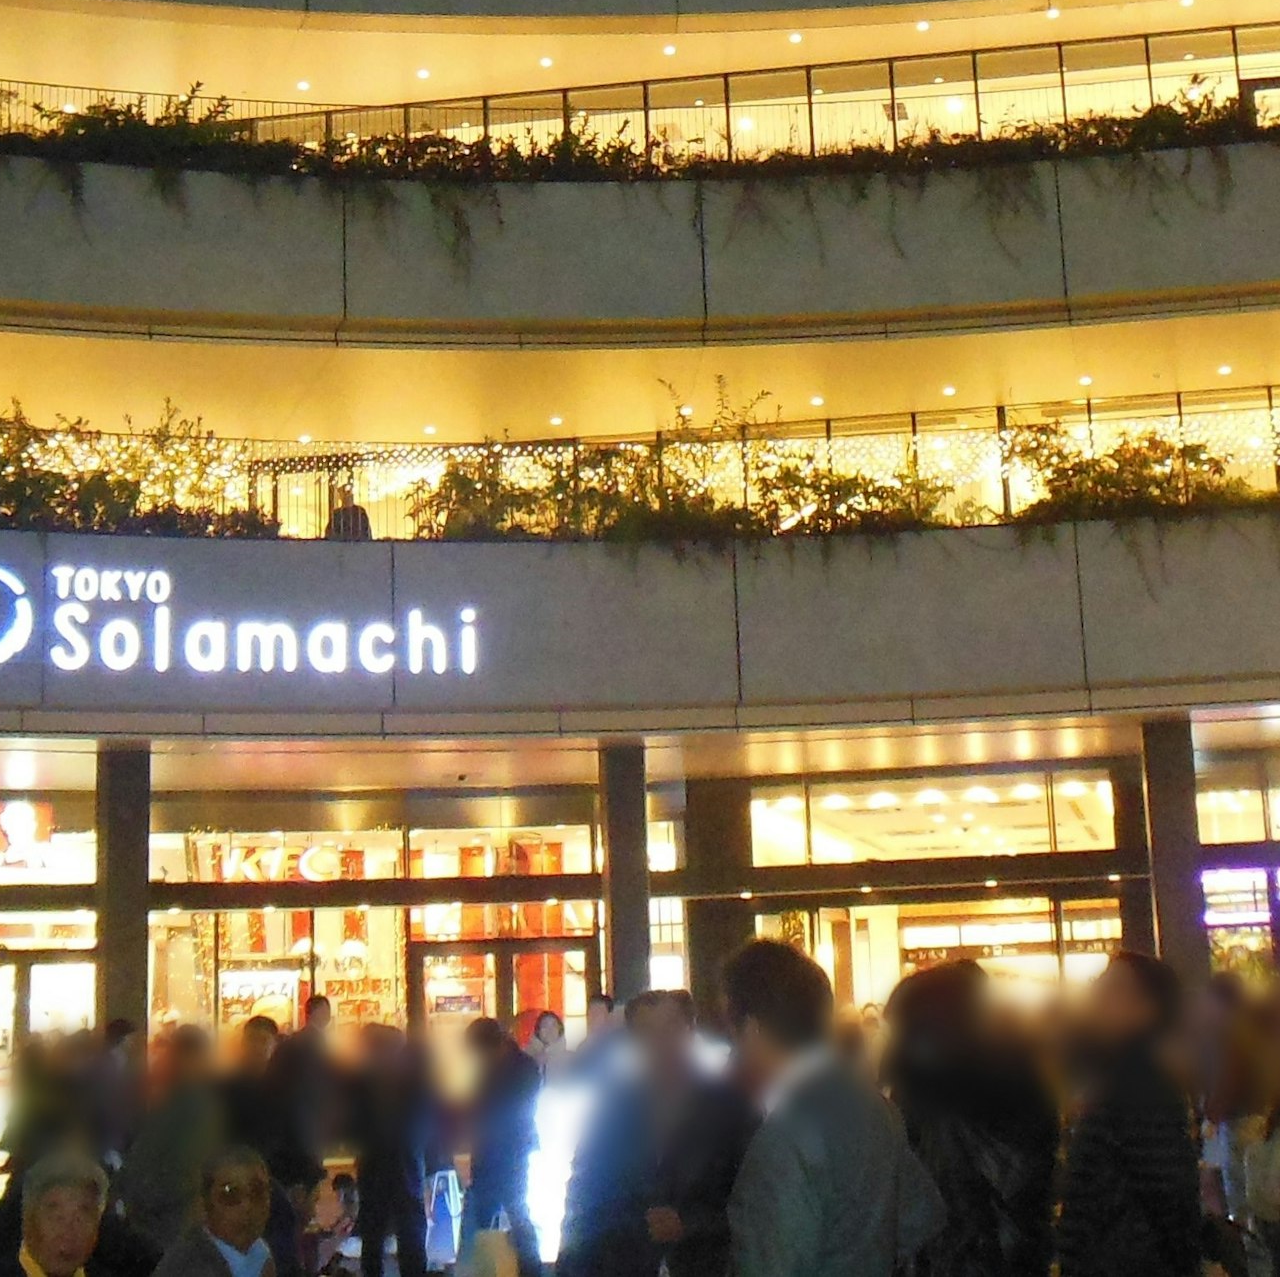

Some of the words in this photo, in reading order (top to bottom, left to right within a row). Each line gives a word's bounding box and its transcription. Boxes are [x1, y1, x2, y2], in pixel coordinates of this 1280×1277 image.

[51, 567, 171, 604] TOKYO
[50, 602, 477, 675] Solamachi
[223, 844, 342, 881] KFC
